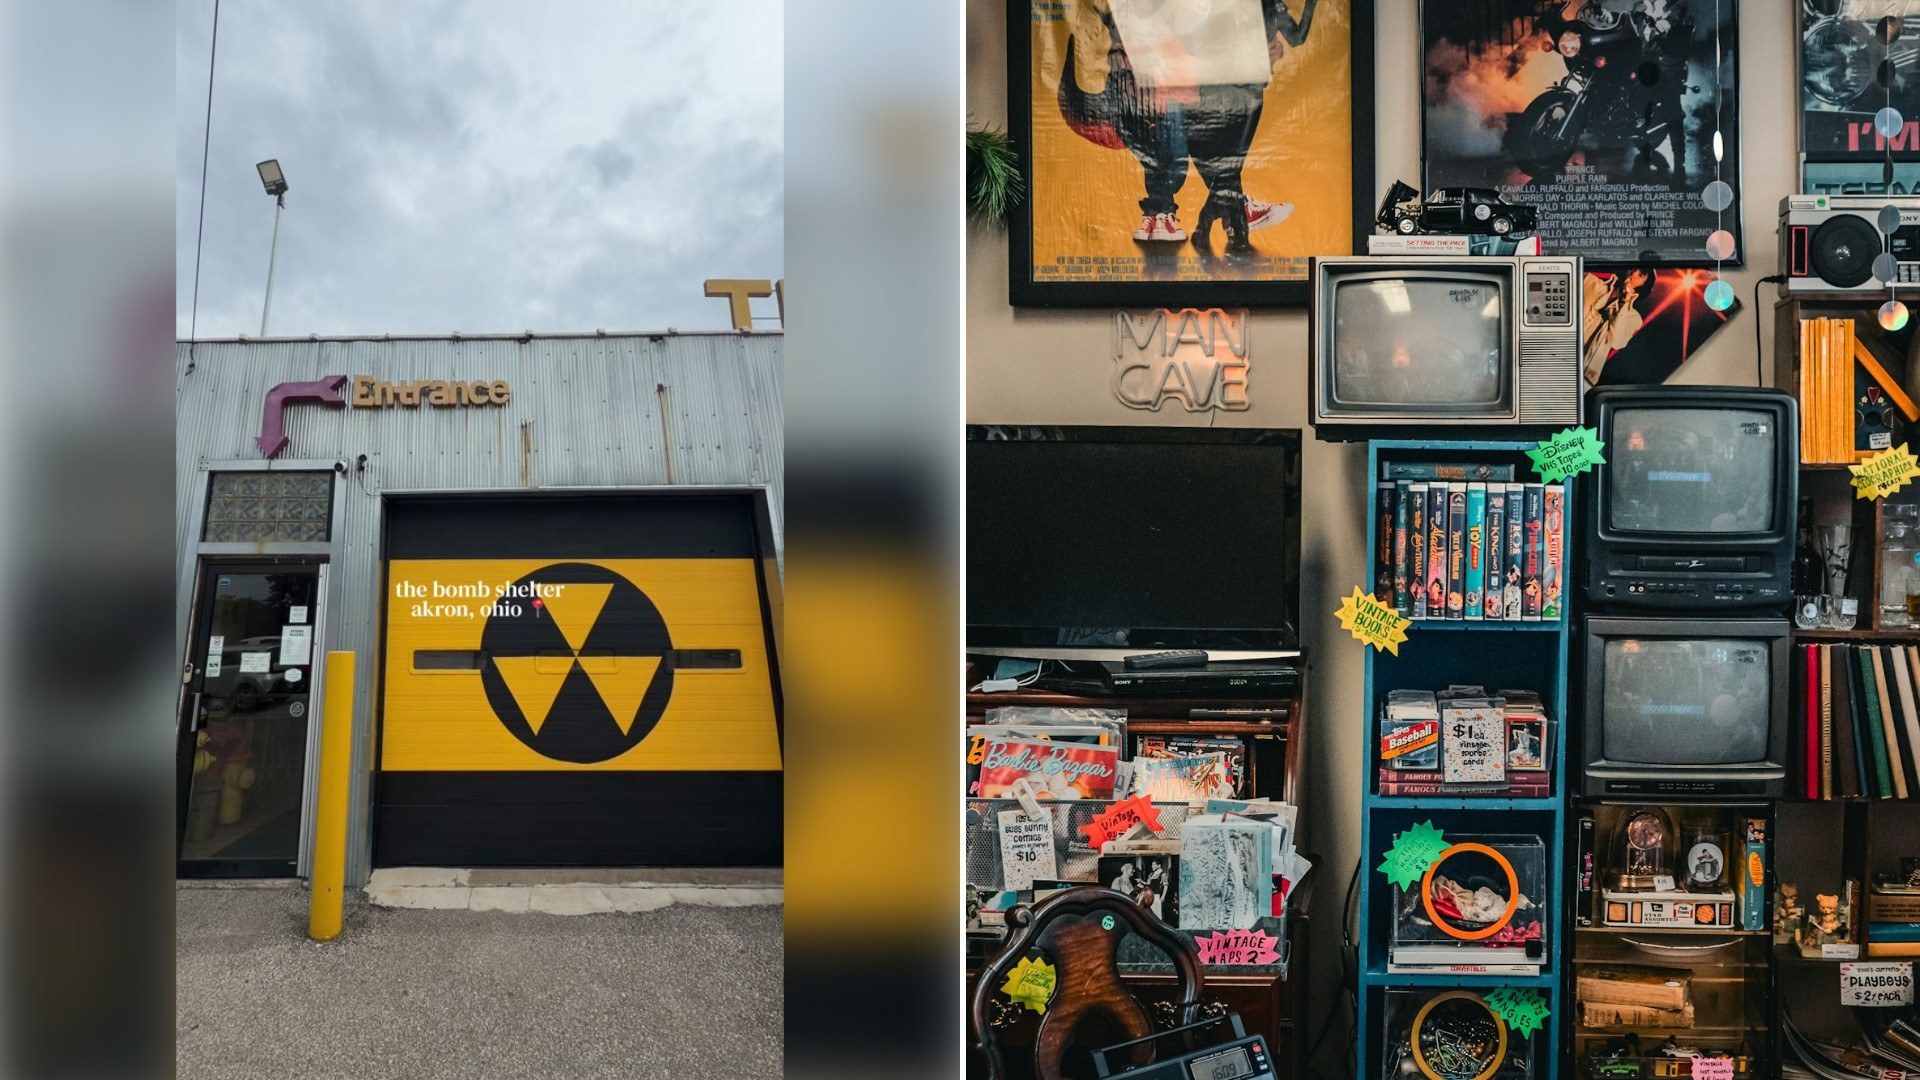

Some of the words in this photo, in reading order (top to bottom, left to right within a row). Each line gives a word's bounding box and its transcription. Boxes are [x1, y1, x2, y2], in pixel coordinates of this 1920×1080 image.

[1555, 175, 1587, 183] PURPLE
[1588, 174, 1608, 182] RAIN
[1566, 165, 1596, 174] PRINCE
[1501, 184, 1538, 193] CAVALLO,
[1540, 184, 1574, 192] RUFFALO
[1590, 184, 1628, 192] FARGNOLI
[1630, 183, 1670, 192] Production
[1512, 193, 1544, 202] MORRIS
[1565, 193, 1587, 201] OLGA
[1588, 192, 1628, 201] KARLATOS
[1629, 193, 1643, 201] and
[1644, 192, 1685, 201] CLARENCE
[1544, 211, 1583, 221] Composed
[1584, 211, 1598, 219] and
[1600, 211, 1634, 219] Produced
[1635, 211, 1645, 220] by
[1646, 211, 1676, 219] PRINCE
[1594, 202, 1617, 210] Music
[1619, 202, 1640, 210] Score
[1641, 202, 1651, 211] by
[1652, 201, 1681, 209] MICHEL
[1536, 220, 1561, 229] LBERT
[1562, 220, 1598, 228] MAGNOLI
[1599, 220, 1613, 228] and
[1614, 220, 1648, 228] WILLIAM
[1566, 229, 1594, 237] JOSEPH
[1594, 229, 1632, 237] RUFFALO
[1633, 229, 1647, 237] and
[1648, 228, 1678, 237] STEVEN
[1679, 228, 1718, 237] FARGNO
[1559, 239, 1569, 248] by
[1570, 239, 1598, 247] ALBERT
[1601, 238, 1638, 246] MAGNOLI
[703, 278, 784, 331] T
[1115, 310, 1247, 358] MAN
[352, 374, 511, 407] Entrance
[1117, 361, 1247, 408] CAVE
[1539, 460, 1558, 472] VHS
[1556, 450, 1583, 465] Tapes
[1574, 459, 1591, 471] each
[1855, 451, 1907, 476] NATIONAL
[1856, 460, 1914, 490] GEOGRAPHICS
[1429, 516, 1445, 568] Aladdin
[1469, 523, 1482, 550] TOY
[1491, 526, 1500, 556] KING
[1525, 519, 1542, 575] PINOCCHIO
[1355, 596, 1401, 629] VINTAGE
[1354, 611, 1391, 639] BOOKS
[1452, 723, 1473, 739] $1
[1823, 702, 1831, 738] MIRROR
[1389, 723, 1433, 750] Baseball
[1459, 740, 1488, 750] vintage
[984, 741, 1042, 773] Barbie
[1046, 745, 1114, 783] Bazaar
[1462, 758, 1485, 766] cards
[1101, 808, 1136, 831] Vintage
[1016, 850, 1037, 862] $10
[1207, 936, 1267, 952] VINTAGE
[1208, 950, 1242, 964] MAPS
[1450, 965, 1487, 973] CONVERTIBLES
[1849, 976, 1909, 988] PLAYBOYS
[1492, 989, 1532, 1029] BANGLES
[1516, 988, 1543, 1016] CELETS
